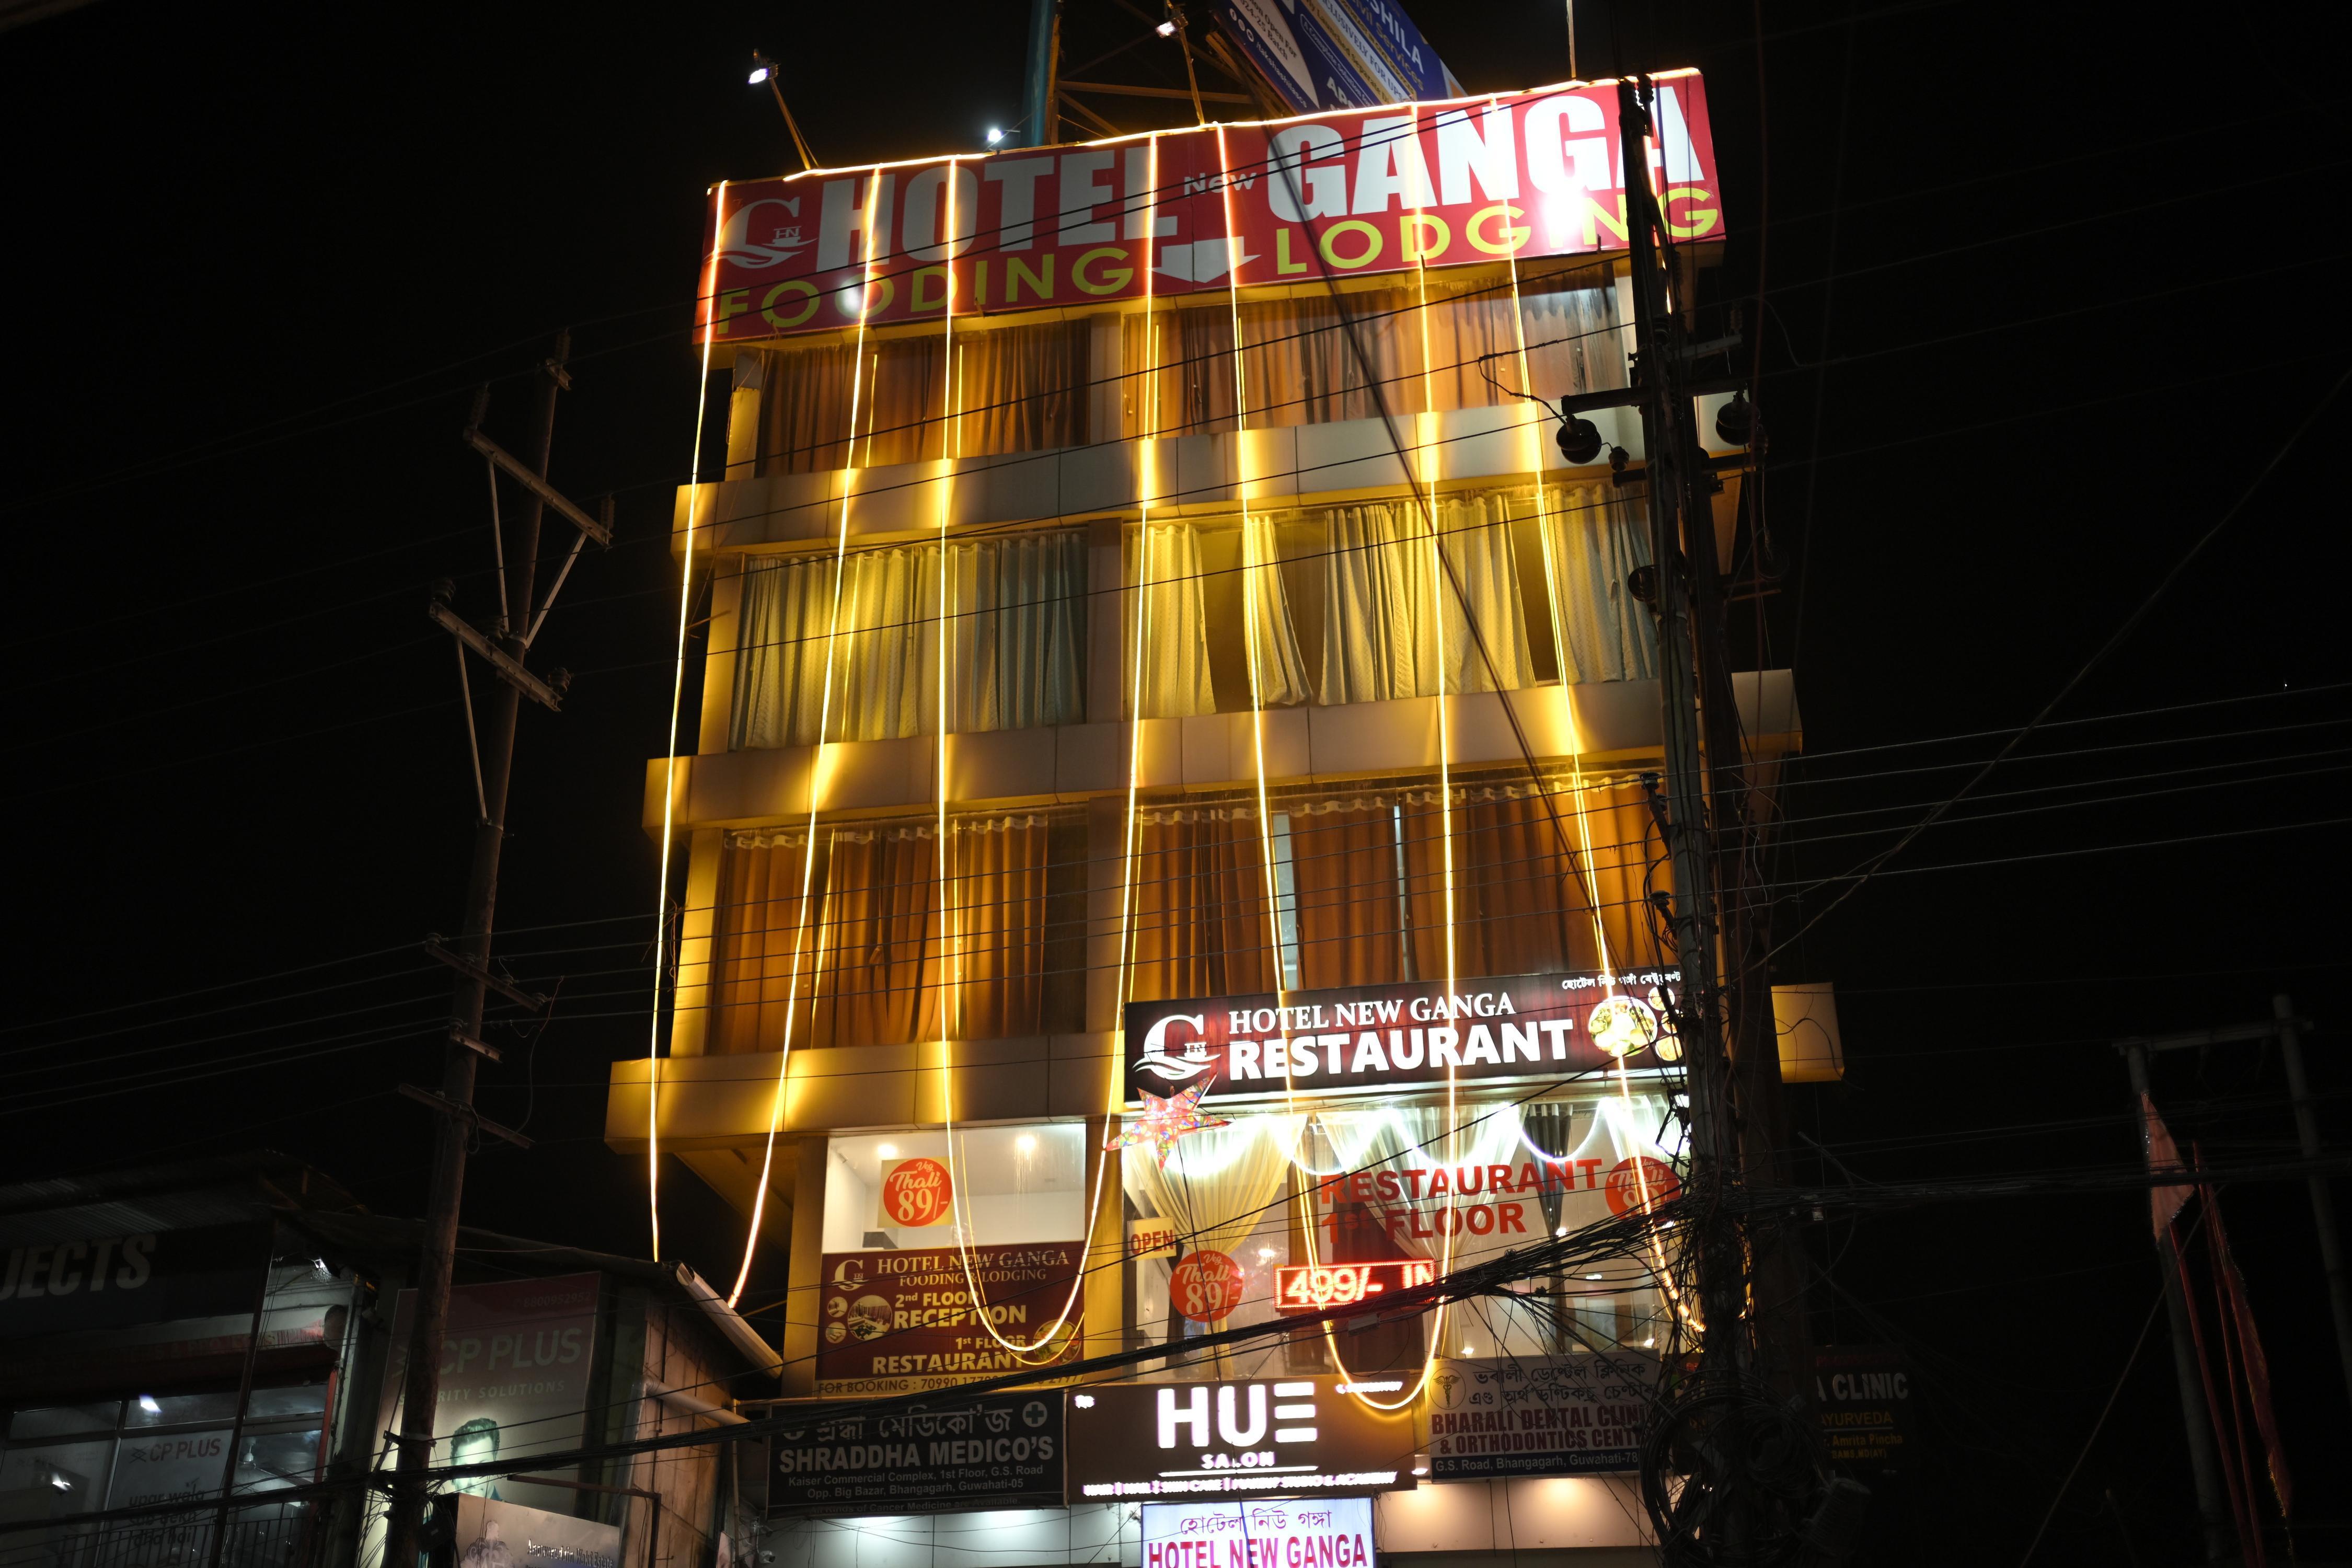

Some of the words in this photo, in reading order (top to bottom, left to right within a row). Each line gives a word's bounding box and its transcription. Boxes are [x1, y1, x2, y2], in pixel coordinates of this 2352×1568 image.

[1265, 14, 1284, 42] Open
[1285, 39, 1296, 57] For
[1268, 30, 1288, 60] Batch
[1370, 56, 1386, 81] FOR
[815, 146, 1178, 272] HOTEL
[1184, 170, 1256, 198] New
[1267, 86, 1704, 222] GANGA
[718, 247, 1134, 335] FOODING
[1229, 1005, 1329, 1035] HOTEL
[1335, 999, 1404, 1027] NEW
[1410, 992, 1517, 1022] GANGA
[1229, 1019, 1574, 1081] RESTAURANT
[916, 1161, 934, 1174] Veg
[889, 1170, 942, 1192] Thali
[1321, 1158, 1602, 1204] RESTAURANT
[897, 1187, 948, 1221] 89/-
[1385, 1202, 1527, 1242] FLOOR
[1130, 1230, 1175, 1255] OPEN
[0, 1233, 156, 1300] JECTS
[877, 1254, 944, 1274] HOTEL
[948, 1252, 996, 1271] NEW
[999, 1250, 1070, 1268] GANGA
[1204, 1253, 1223, 1264] Veg
[899, 1272, 965, 1287] FOODING
[982, 1269, 1046, 1282] LODGING
[1176, 1263, 1233, 1285] Thali
[1285, 1266, 1383, 1304] 499/-
[895, 1293, 918, 1308] 2nd
[923, 1291, 979, 1307] FLOOR
[440, 1334, 480, 1376] CP
[489, 1328, 583, 1369] PLUS
[955, 1337, 971, 1350] 1st
[975, 1334, 1027, 1350] FLOOR
[873, 1351, 1027, 1375] RESTAURANT
[478, 1380, 566, 1400] SOLUTIONS
[818, 1382, 843, 1394] FOR
[847, 1379, 909, 1392] BOOKING
[921, 1377, 958, 1390] 70990
[1832, 1372, 1909, 1401] CLINIC
[1157, 1381, 1317, 1449] HUE
[1432, 1410, 1514, 1435] BHARALI
[1521, 1407, 1593, 1431] DENTAL
[149, 1442, 173, 1462] CP
[176, 1438, 222, 1459] PLUS
[1440, 1439, 1452, 1454] &
[1456, 1429, 1588, 1454] ORTHODONTICS
[1832, 1434, 1866, 1447] Amrita
[1869, 1432, 1904, 1445] Pincha
[779, 1443, 921, 1473] SHRADDHA
[929, 1436, 1054, 1467] MEDICO'S
[1201, 1451, 1275, 1469] SALON
[1436, 1460, 1459, 1472] G.S.
[1461, 1457, 1493, 1472] Road,
[1496, 1453, 1566, 1470] Bhangagarh,
[789, 1474, 822, 1486] Kaiser
[824, 1472, 885, 1485] Commercial
[888, 1469, 937, 1483] Complex,
[940, 1468, 956, 1479] 1st
[959, 1466, 988, 1479] Floor,
[991, 1465, 1013, 1477] G.S.
[1016, 1464, 1043, 1475] Road
[807, 1488, 832, 1501] Opp.
[835, 1486, 852, 1499] Big
[855, 1484, 887, 1497] Bazar,
[890, 1482, 954, 1496] Bhangagarh,
[959, 1478, 1024, 1492] Guwahati-05
[857, 1504, 867, 1513] of
[869, 1503, 905, 1512] Cancer
[907, 1501, 952, 1511] Medicine
[1181, 1511, 1243, 1535] হোটেল
[1252, 1508, 1289, 1531] নিউ
[1298, 1509, 1332, 1529] গঙ্গা
[1149, 1540, 1221, 1568] HOTEL
[1229, 1538, 1278, 1568] NEW
[1286, 1534, 1368, 1568] GANGA
